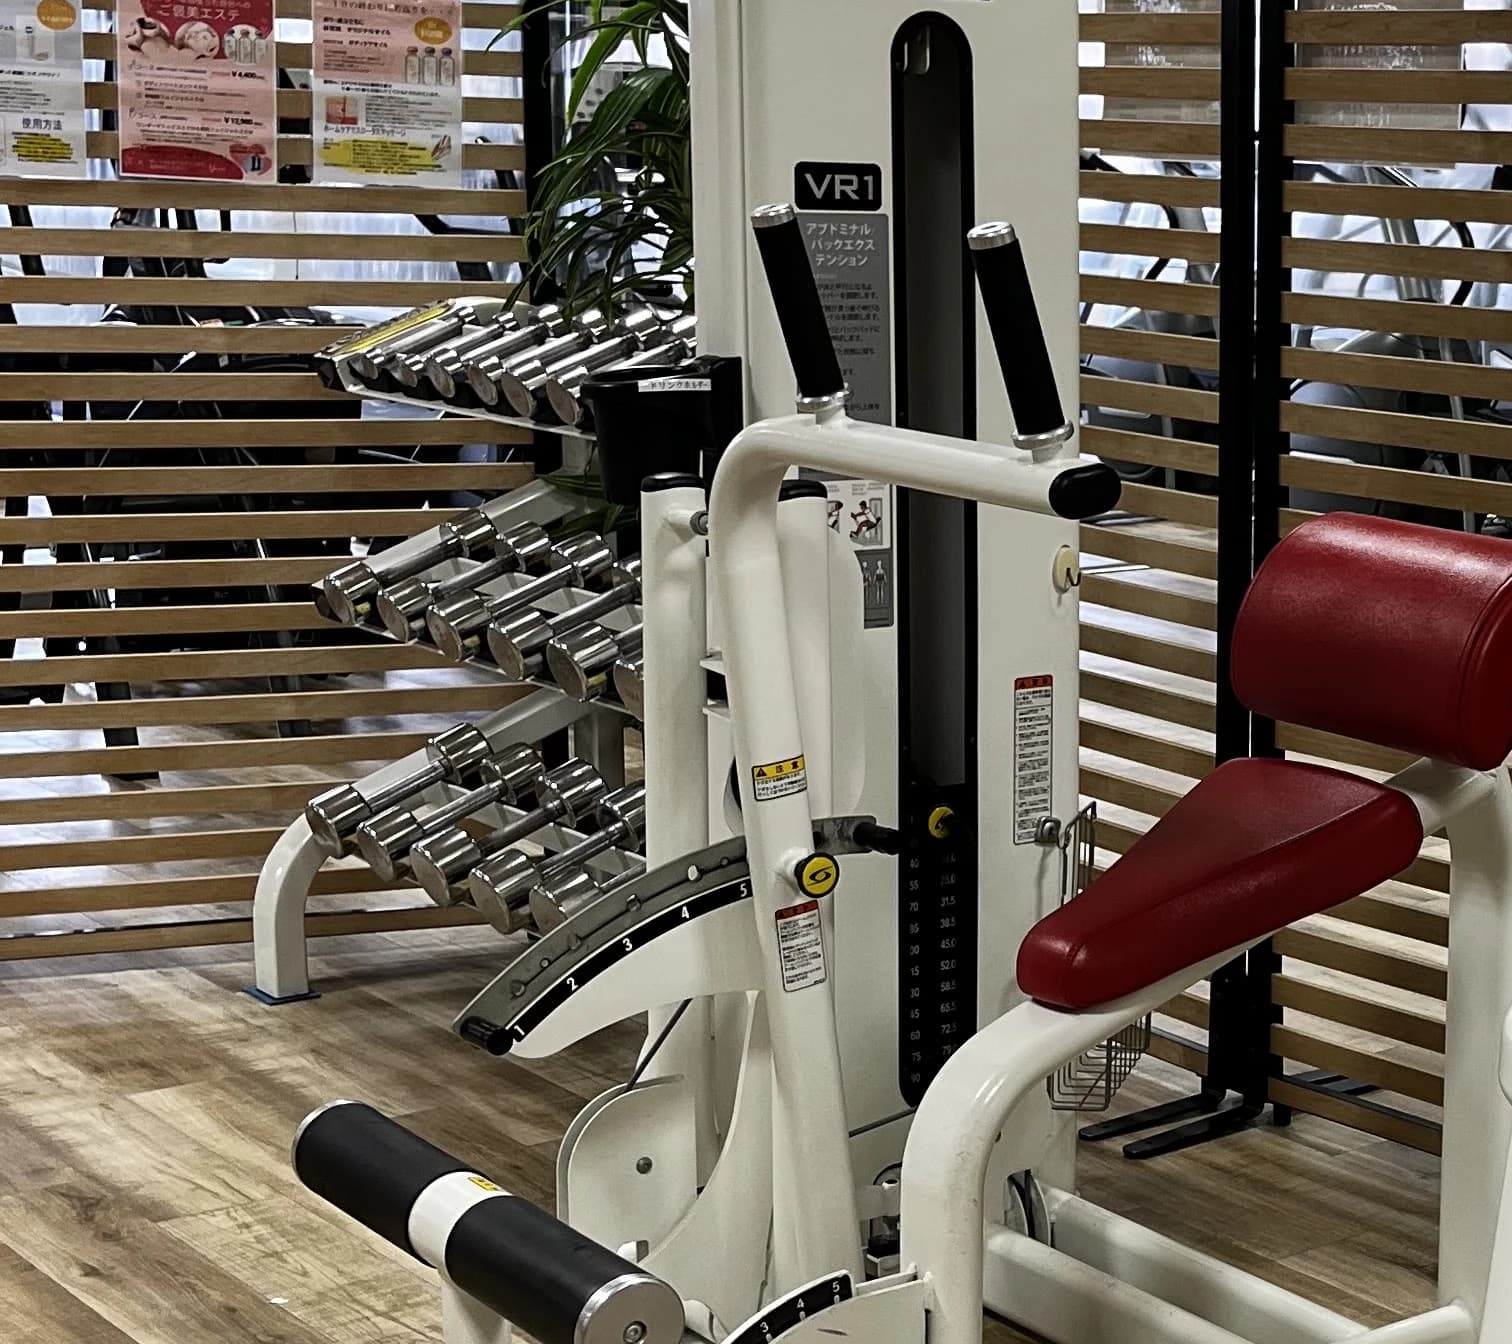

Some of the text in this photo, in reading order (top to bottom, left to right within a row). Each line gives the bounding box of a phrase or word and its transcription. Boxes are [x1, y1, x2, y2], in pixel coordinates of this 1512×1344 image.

[804, 173, 874, 200] VR1
[740, 883, 748, 895] 5
[681, 906, 690, 918] 4
[622, 938, 632, 951] 3
[567, 977, 579, 991] 2
[513, 1025, 526, 1037] 1
[832, 1281, 840, 1293] 5
[796, 1298, 805, 1309] 4
[760, 1321, 769, 1332] 3
